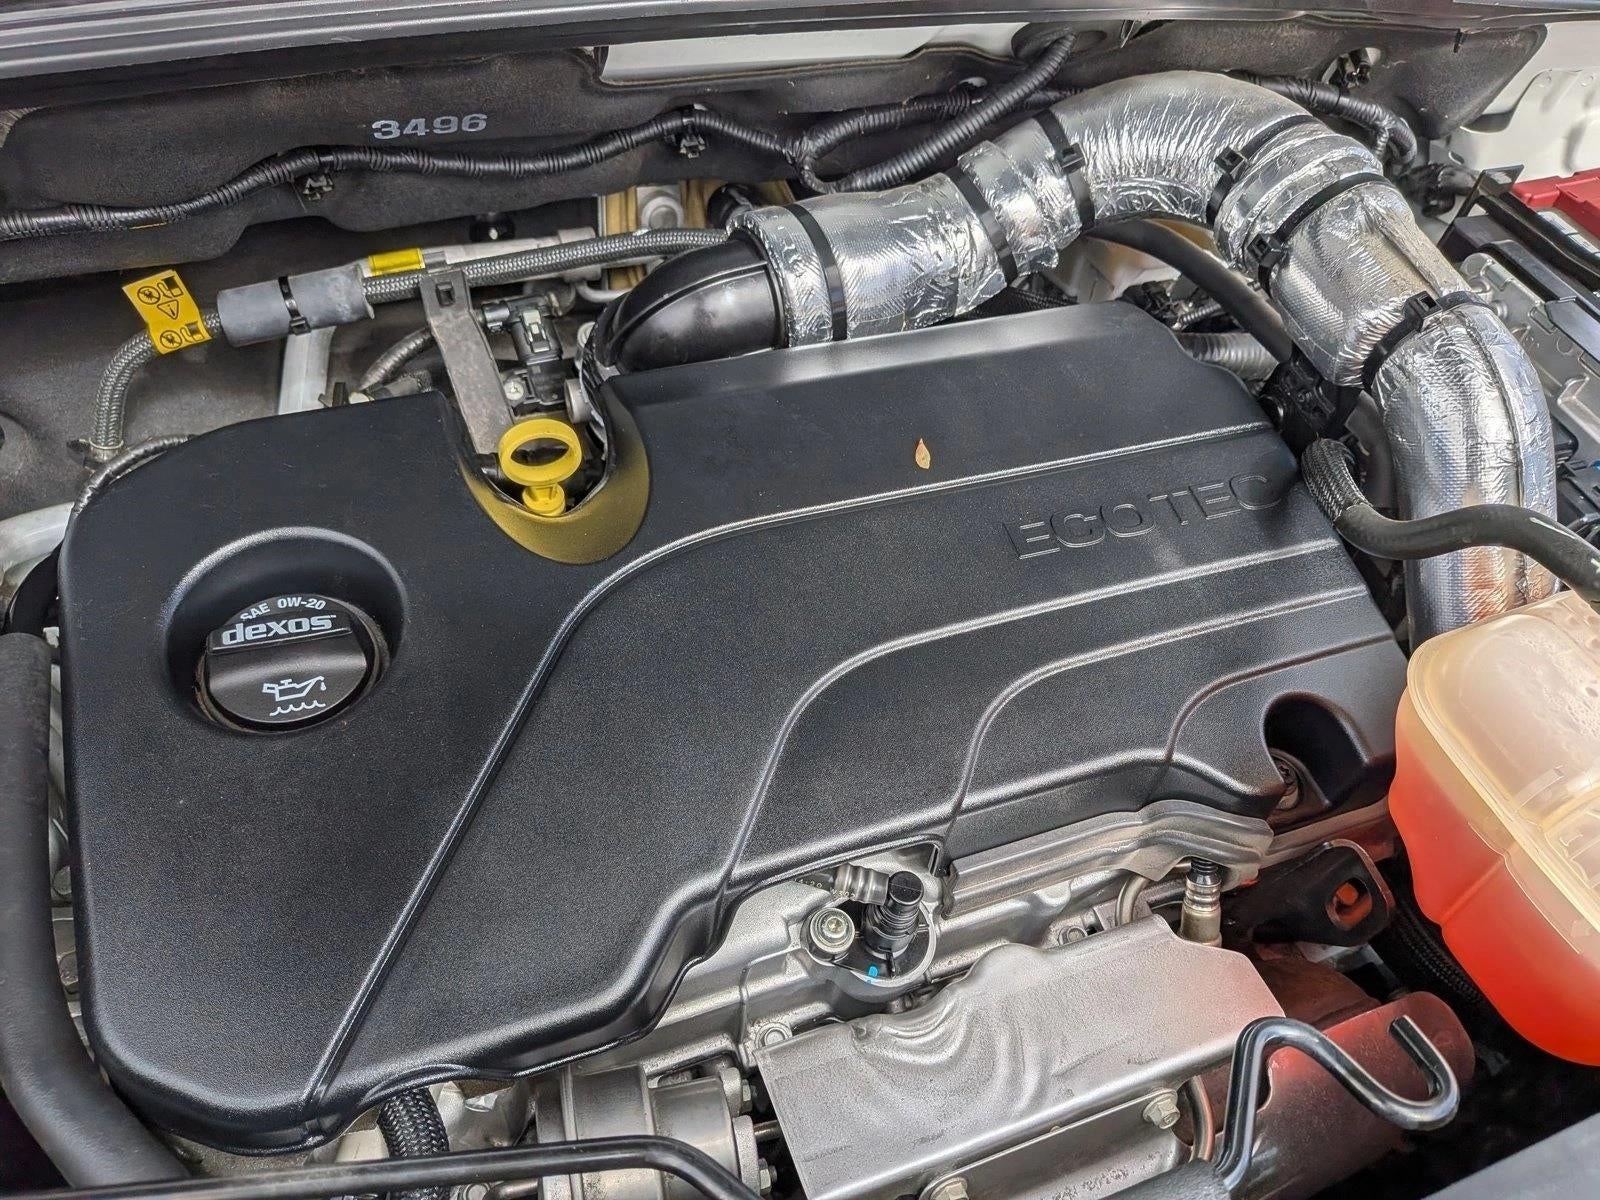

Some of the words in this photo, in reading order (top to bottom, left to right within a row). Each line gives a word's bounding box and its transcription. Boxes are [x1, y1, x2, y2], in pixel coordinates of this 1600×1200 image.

[371, 113, 488, 140] 3496
[1002, 475, 1281, 560] ECOTEC
[240, 602, 270, 621] SAE
[277, 596, 326, 610] 0W-20
[222, 615, 333, 646] dexos
